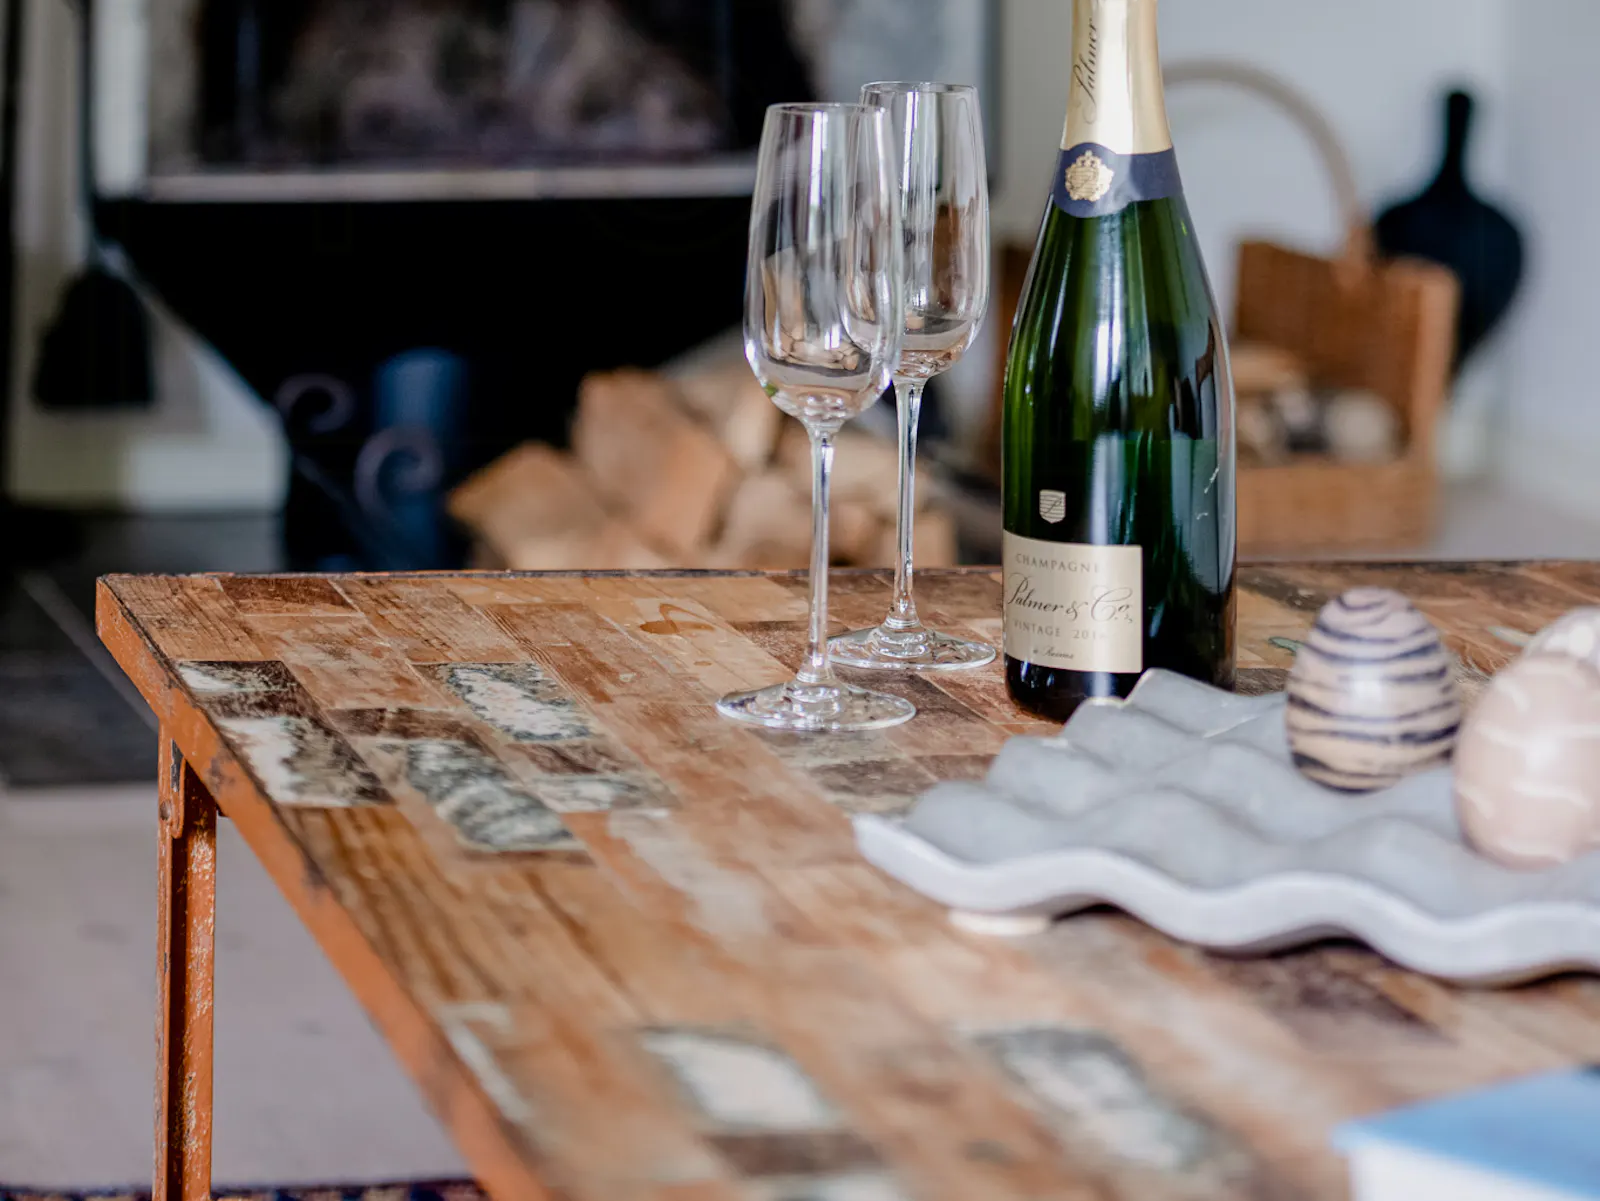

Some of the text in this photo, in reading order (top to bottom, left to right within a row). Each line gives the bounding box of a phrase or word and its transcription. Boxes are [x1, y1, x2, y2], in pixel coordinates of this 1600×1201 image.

[1072, 17, 1099, 125] Palmer
[1007, 571, 1064, 613] Palmer
[1065, 600, 1089, 622] &
[1013, 618, 1107, 640] VINTAGE 201
